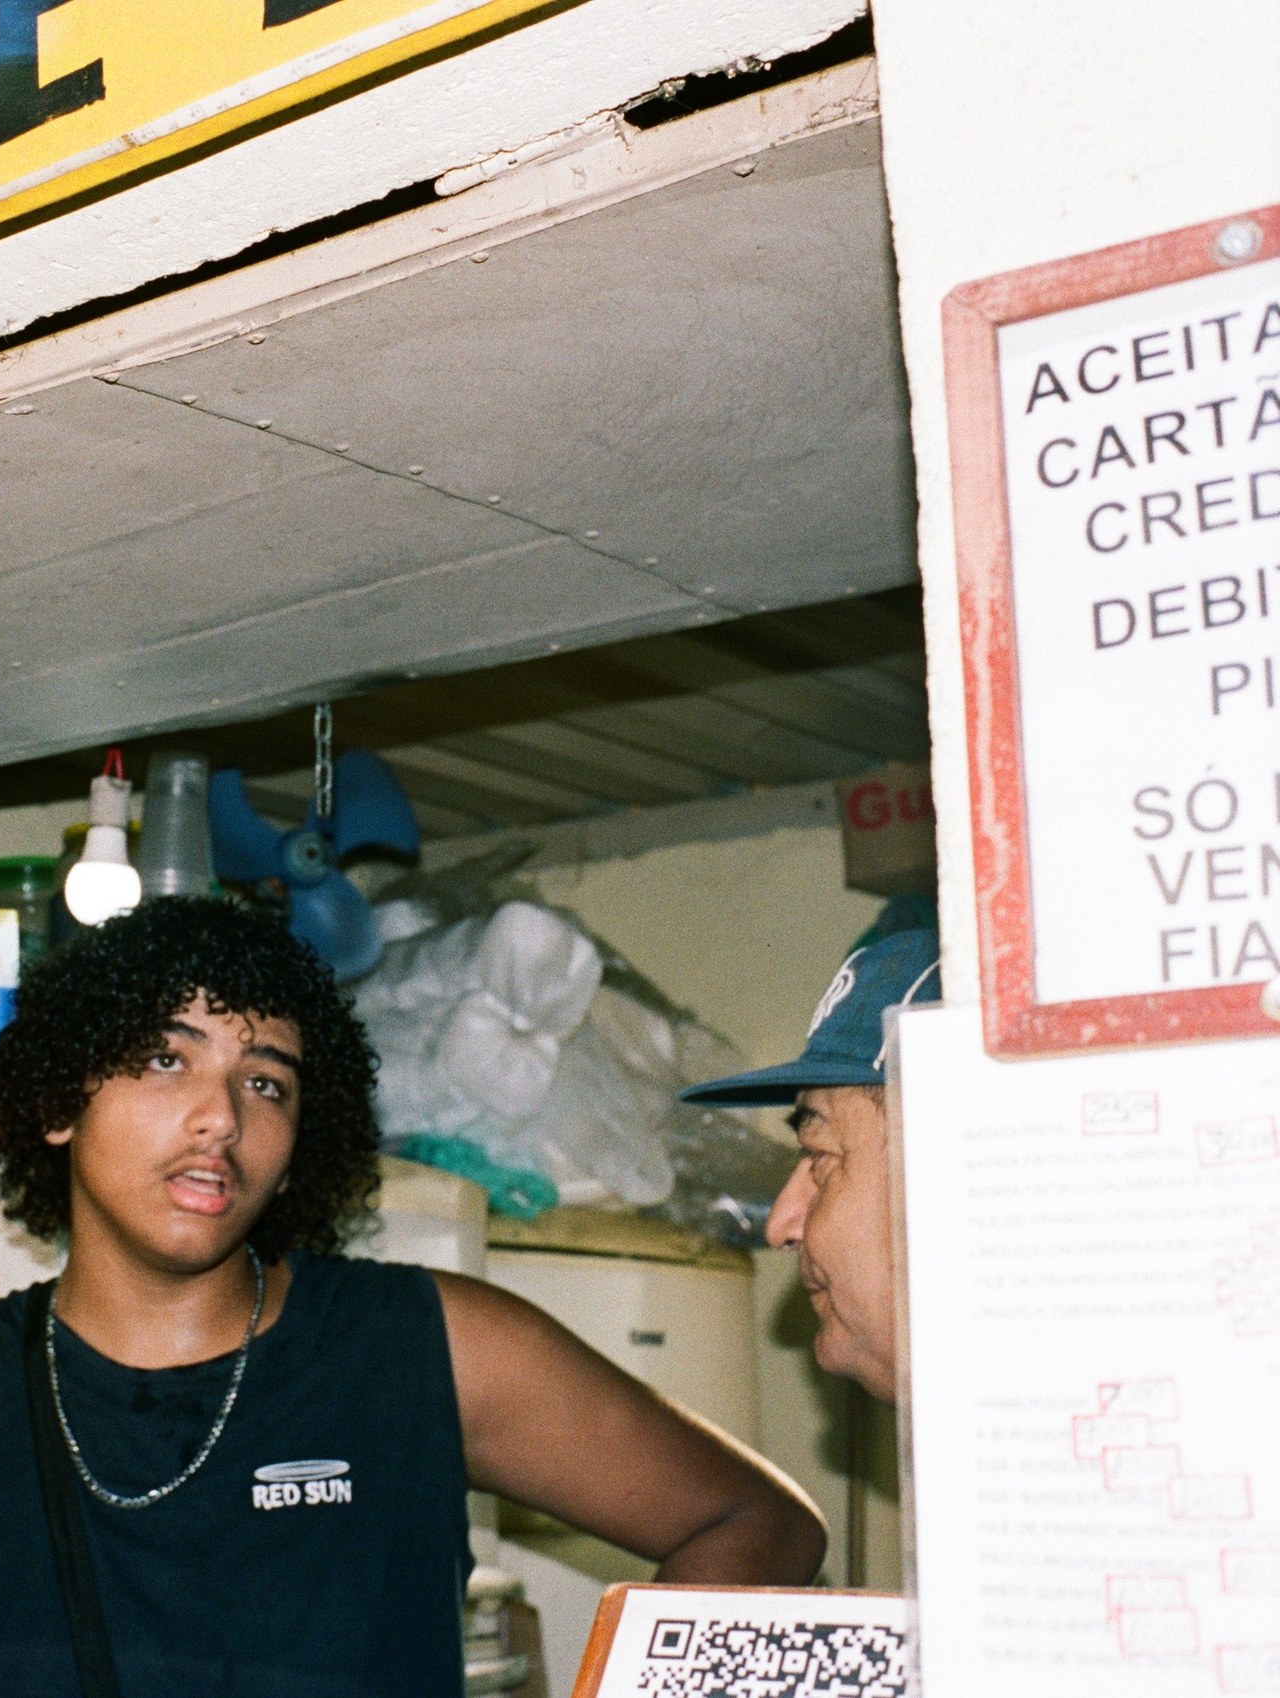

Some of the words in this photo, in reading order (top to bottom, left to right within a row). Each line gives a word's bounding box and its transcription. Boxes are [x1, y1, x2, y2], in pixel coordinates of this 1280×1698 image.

[1092, 565, 1280, 651] DEBI
[1210, 656, 1275, 717] PI
[1132, 763, 1239, 841] SÓ
[251, 1482, 302, 1511] RED
[303, 1478, 353, 1506] SUN
